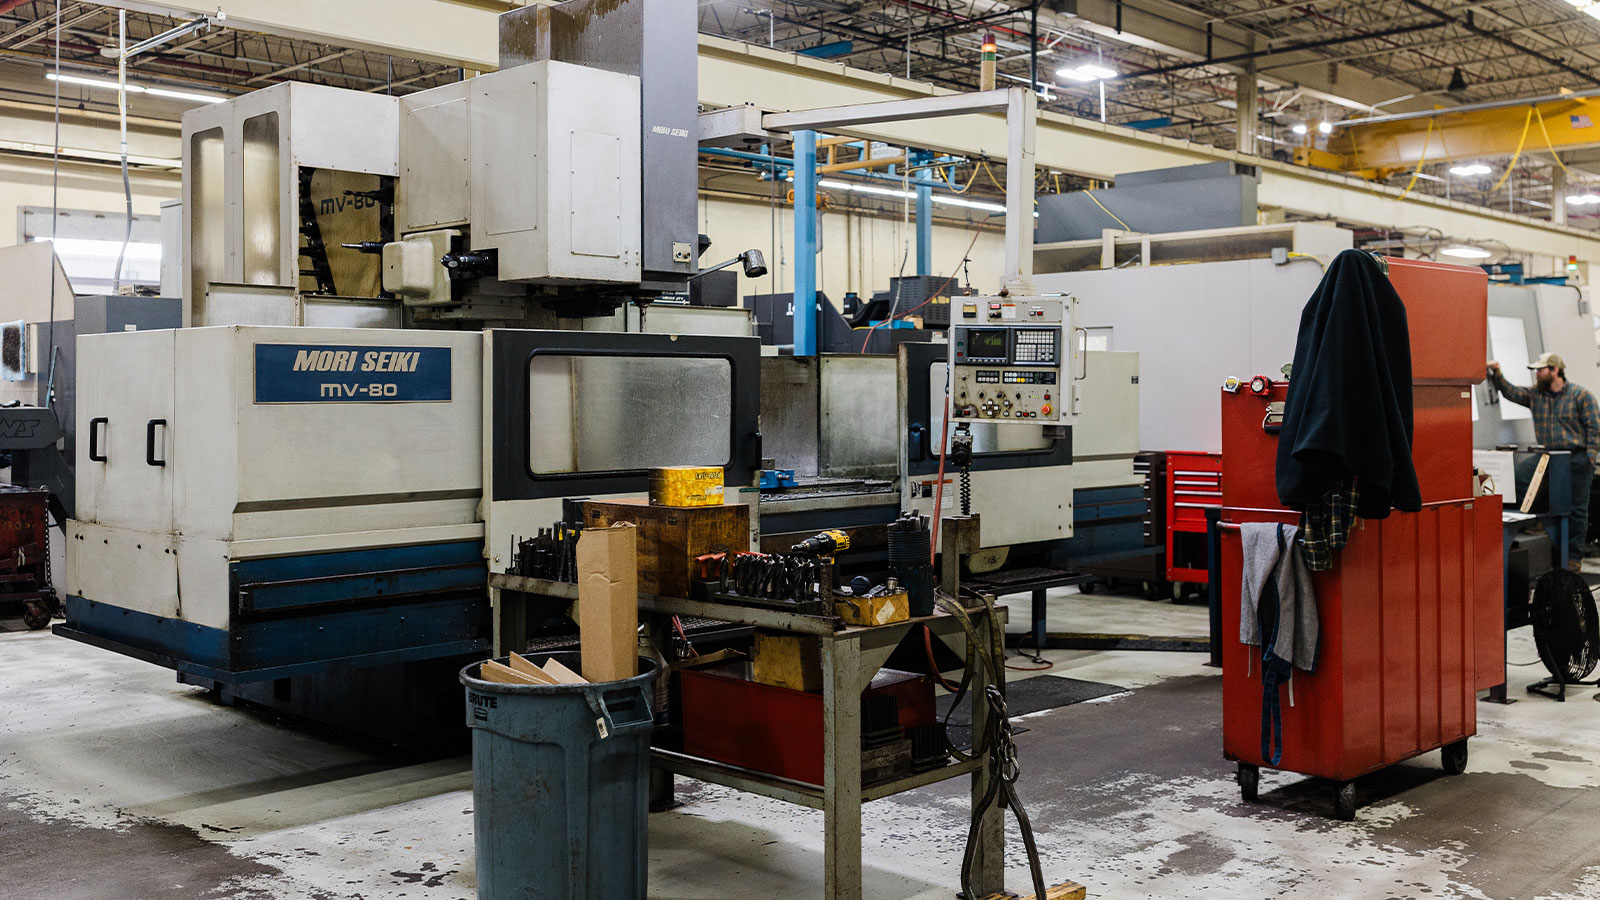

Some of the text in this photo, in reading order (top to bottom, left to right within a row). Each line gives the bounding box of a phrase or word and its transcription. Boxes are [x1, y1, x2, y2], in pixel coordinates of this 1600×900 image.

[652, 125, 689, 138] MORI SEIKI
[293, 350, 420, 373] MORI SEIKI
[320, 383, 398, 397] MV-80
[468, 691, 498, 709] BRUTE
